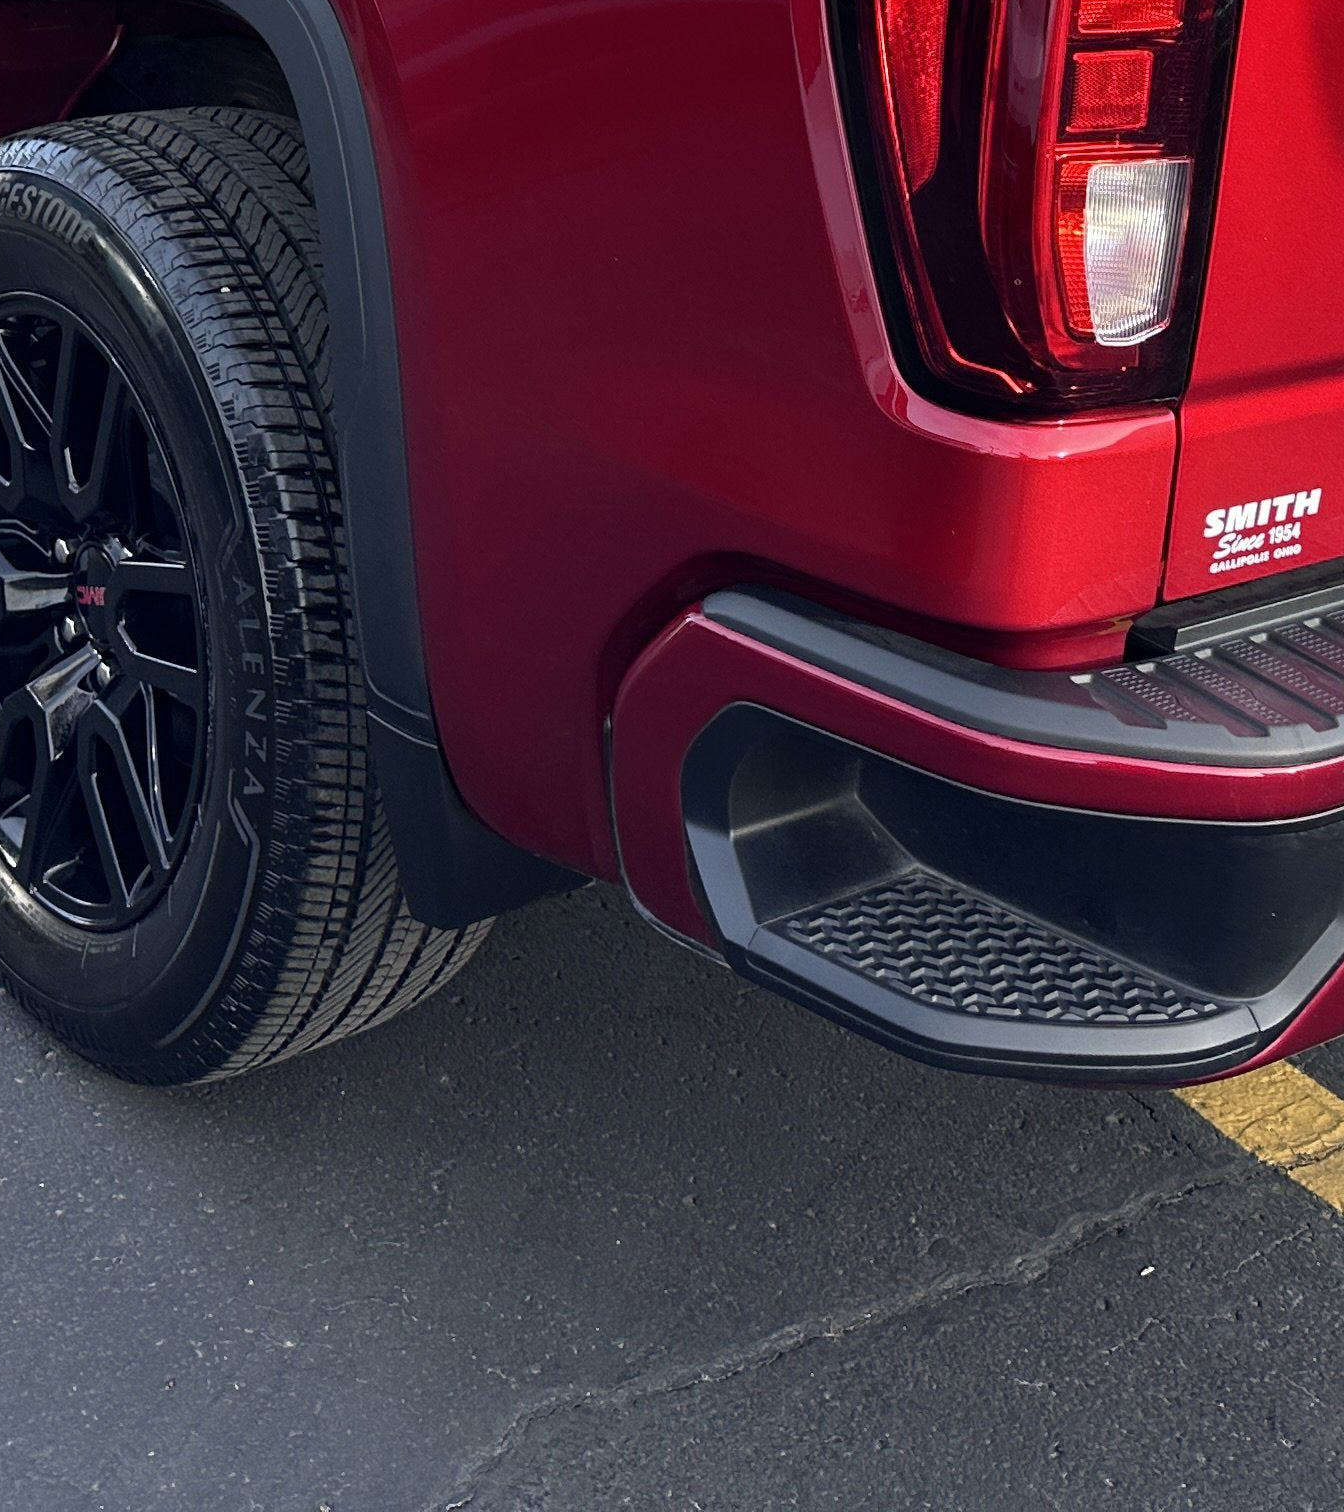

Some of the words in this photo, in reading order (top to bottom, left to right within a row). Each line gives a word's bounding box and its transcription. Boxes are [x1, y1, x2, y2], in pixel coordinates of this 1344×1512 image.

[1203, 488, 1322, 538] SMITH
[1209, 550, 1270, 574] GALLIPOLIS
[1273, 543, 1302, 559] OHIO
[1212, 532, 1266, 560] Since
[1268, 521, 1301, 544] 1954
[231, 574, 268, 795] ALENZA
